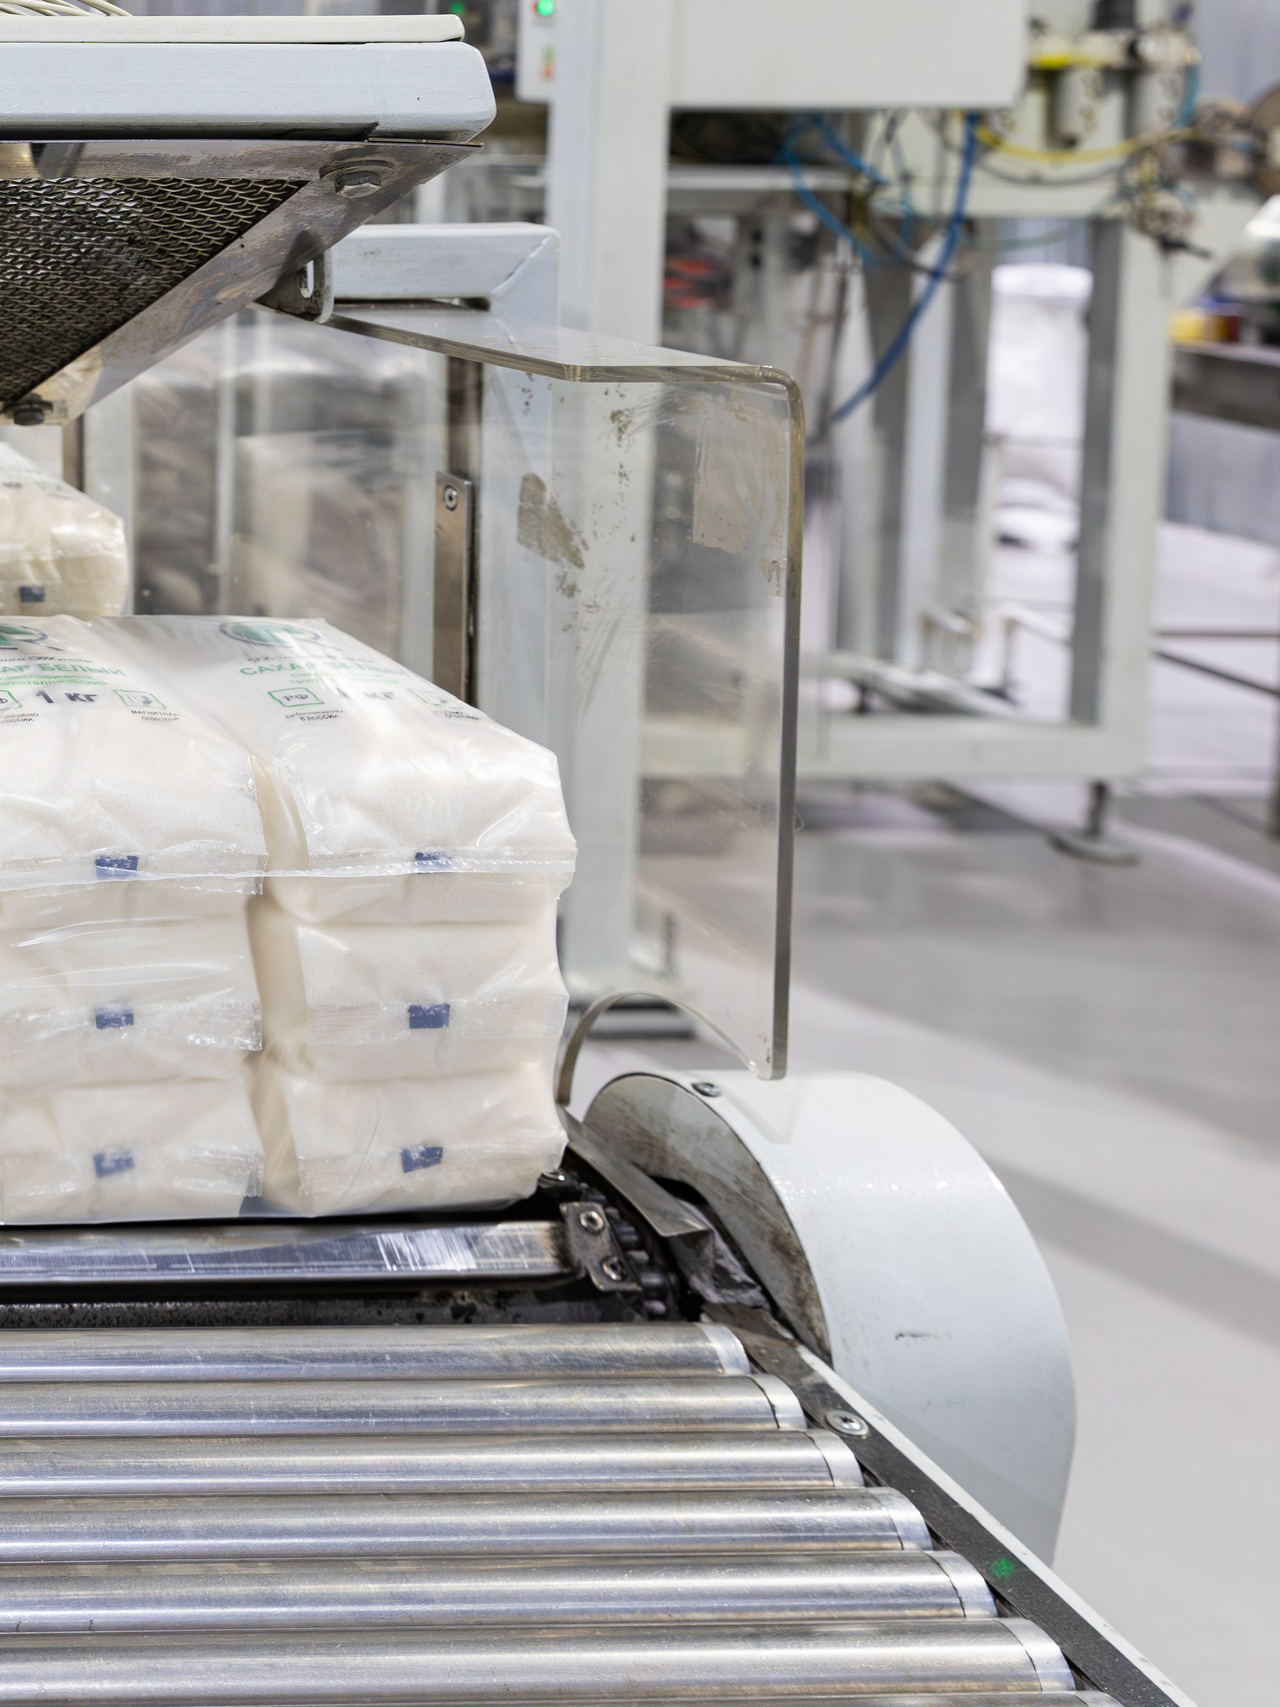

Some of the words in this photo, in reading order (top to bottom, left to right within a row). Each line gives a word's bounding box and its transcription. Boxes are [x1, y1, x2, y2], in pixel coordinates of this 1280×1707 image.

[37, 662, 127, 676] БЕЛЫЙ
[35, 690, 54, 704] 1
[283, 692, 309, 702] РФ
